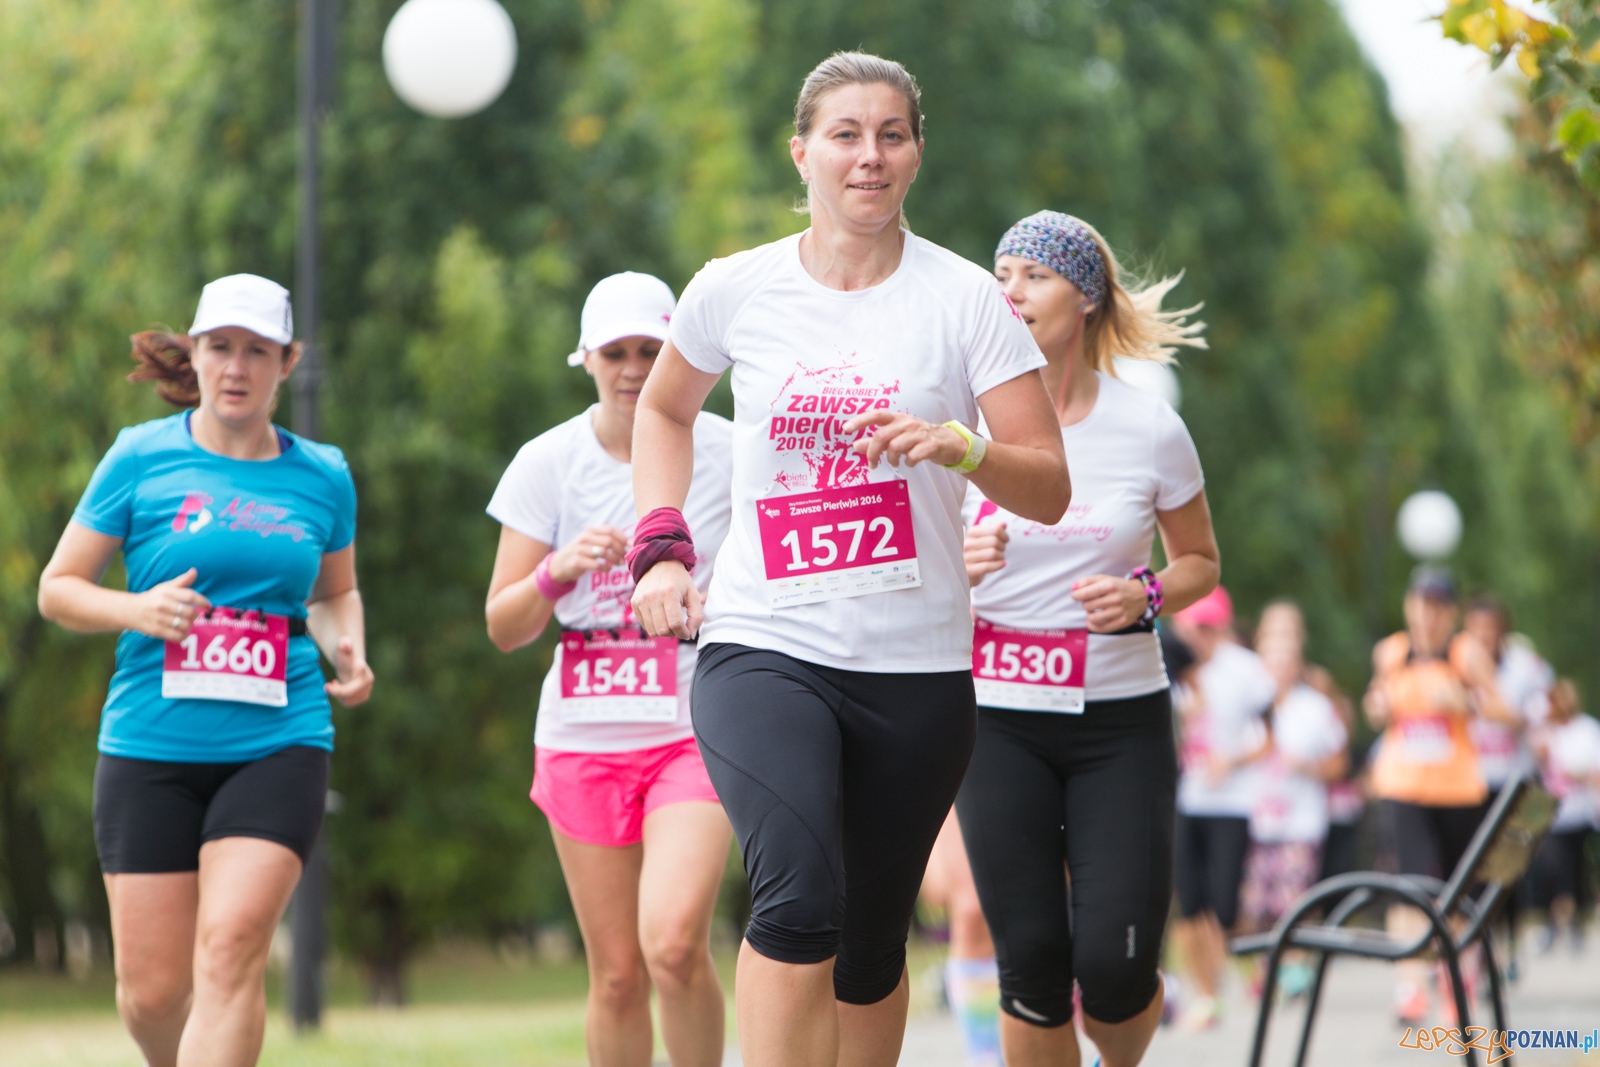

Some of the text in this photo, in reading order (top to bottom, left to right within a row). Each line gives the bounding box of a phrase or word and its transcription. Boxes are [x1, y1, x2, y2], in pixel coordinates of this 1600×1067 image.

[787, 395, 890, 415] zawsze
[822, 387, 880, 398] BIEG KOBIET
[776, 436, 816, 451] 2016
[790, 504, 822, 516] Zawsze
[823, 497, 859, 511] Pier(w)si
[860, 494, 883, 506] 2016
[780, 516, 898, 571] 1572
[180, 634, 276, 676] 1660
[978, 640, 1072, 684] 1530
[572, 657, 662, 695] 1541
